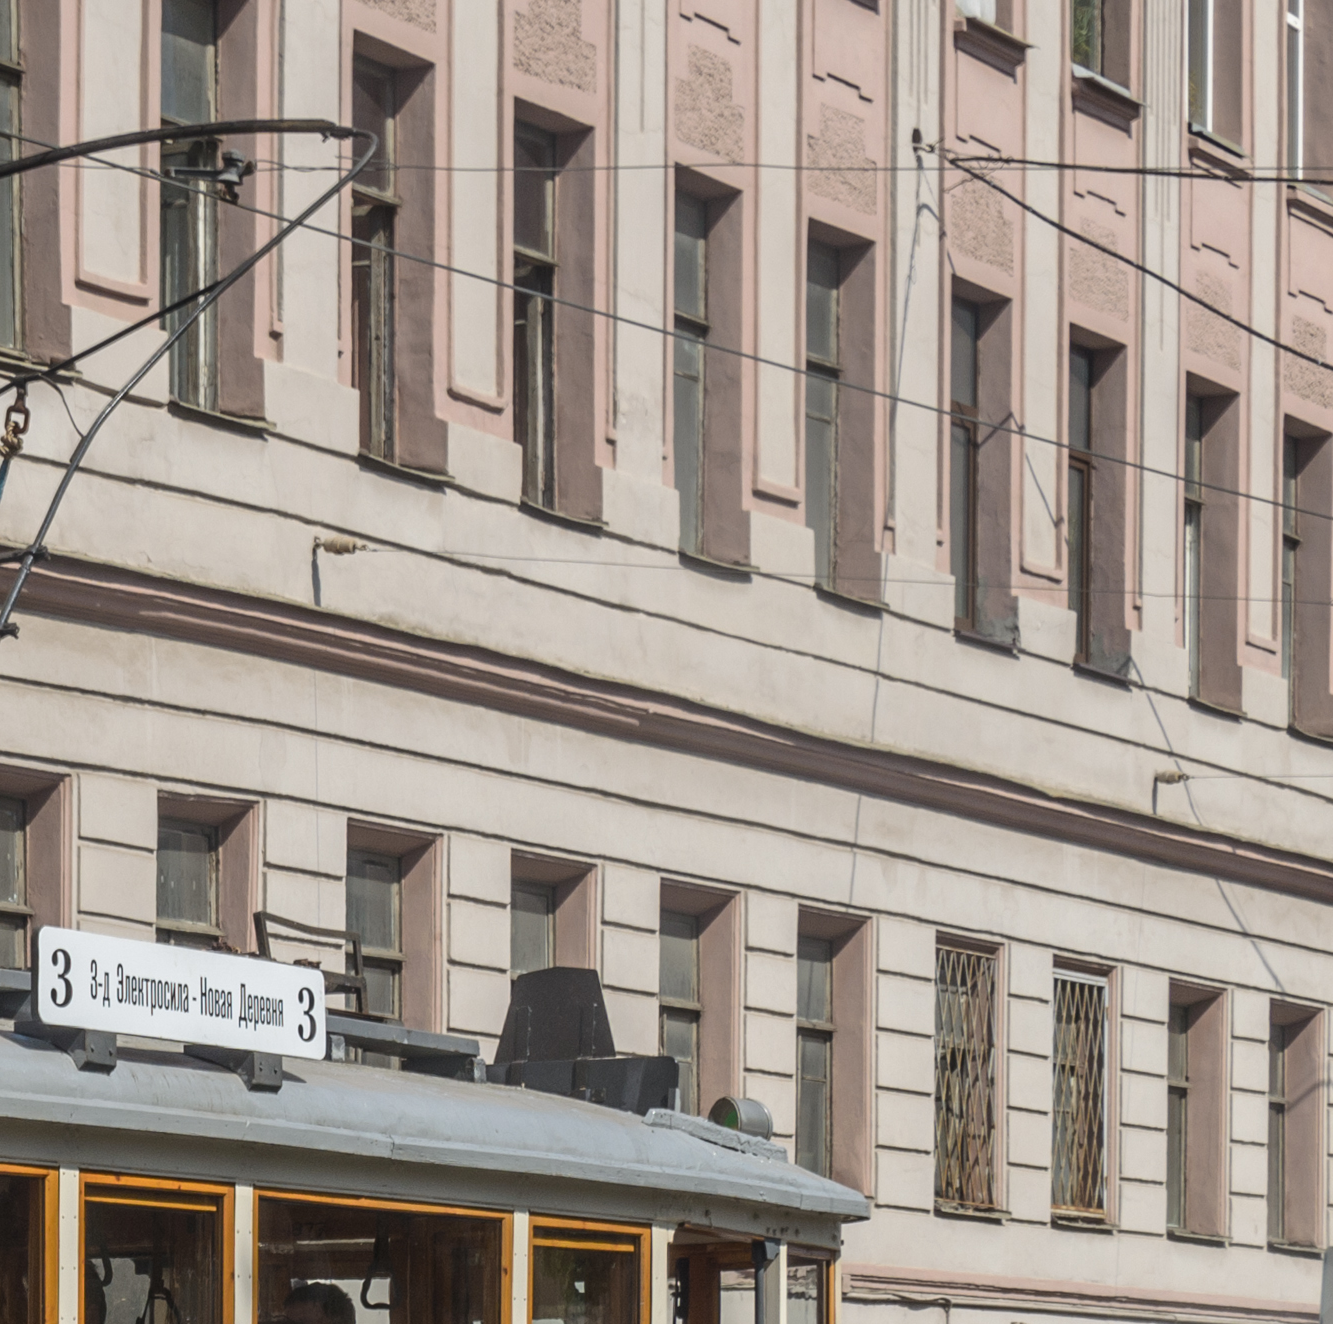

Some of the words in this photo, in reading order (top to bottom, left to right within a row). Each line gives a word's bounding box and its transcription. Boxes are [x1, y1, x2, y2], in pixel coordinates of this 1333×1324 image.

[50, 948, 73, 1008] 3
[116, 963, 189, 1016] Электросила
[200, 976, 233, 1020] Новая
[238, 983, 284, 1031] Деревня
[297, 987, 317, 1042] 3
